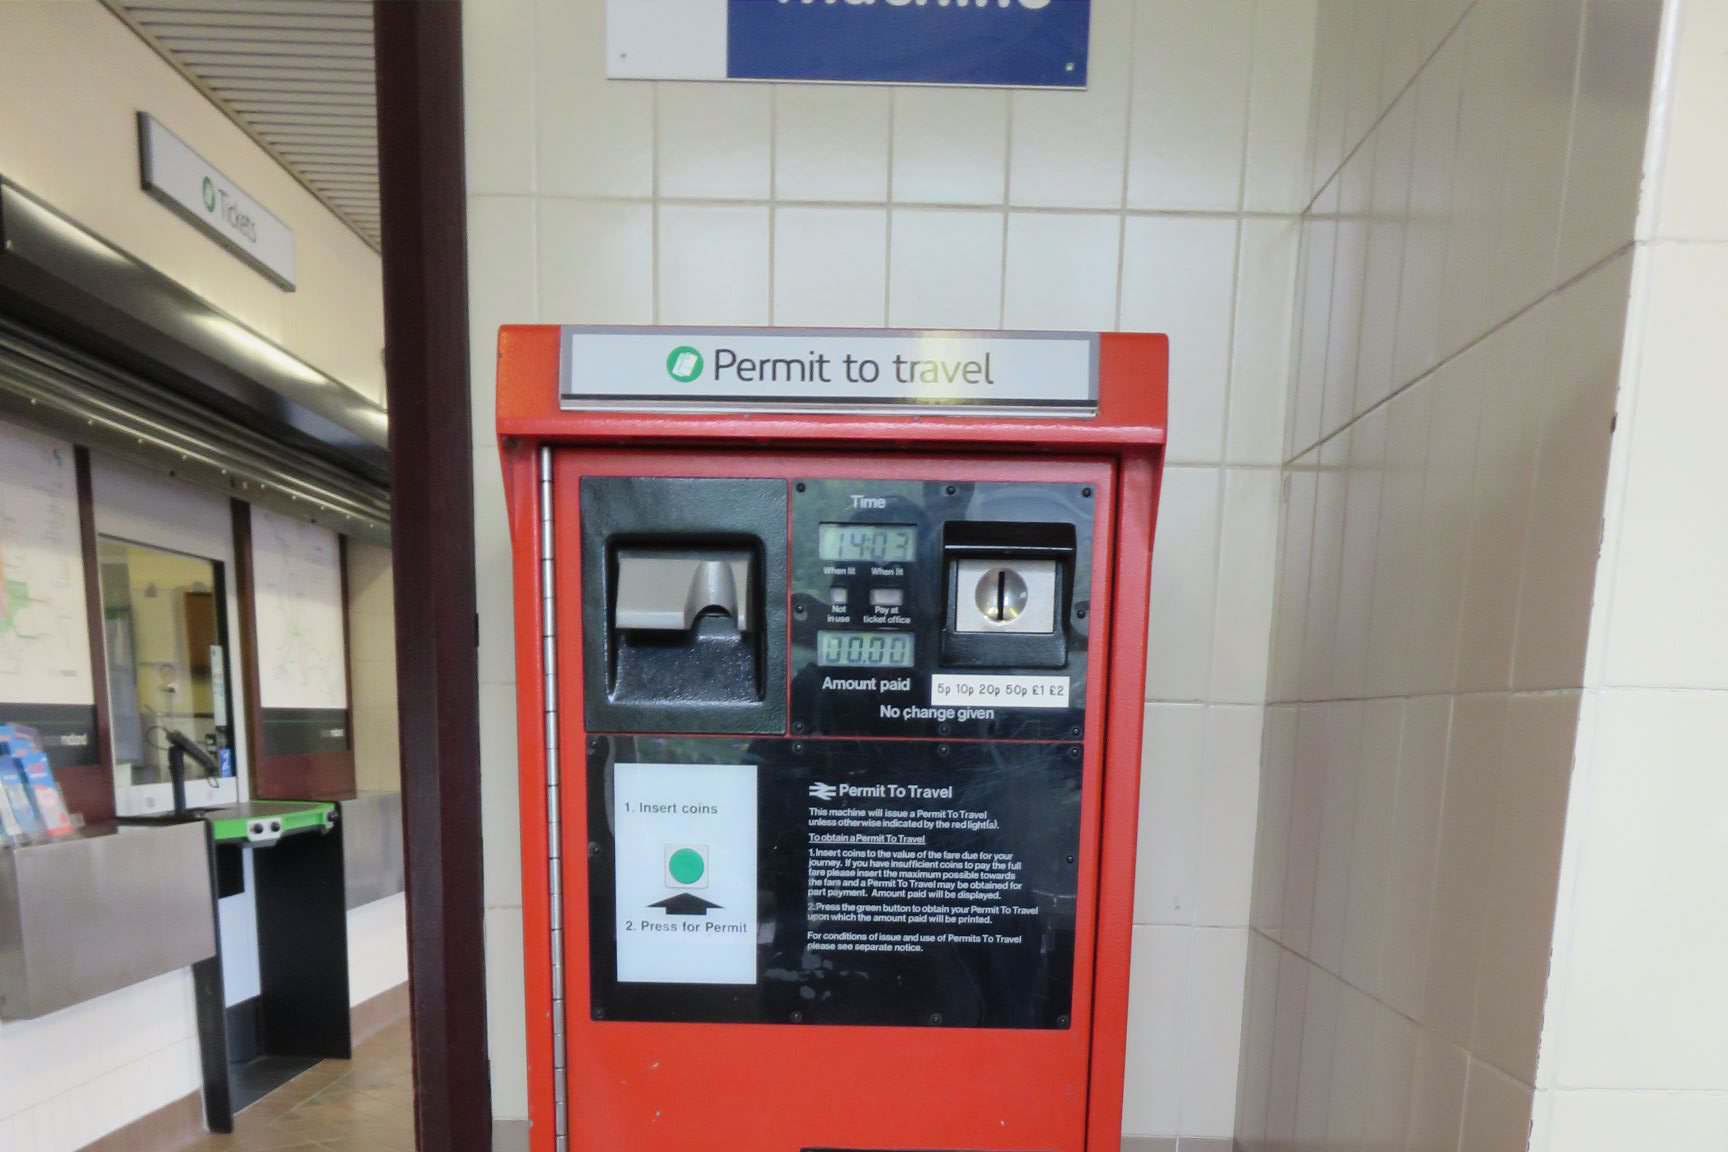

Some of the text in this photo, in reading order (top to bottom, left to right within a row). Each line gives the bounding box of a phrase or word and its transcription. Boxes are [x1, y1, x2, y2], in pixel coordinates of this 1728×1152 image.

[714, 348, 994, 384] Permit to travel
[850, 494, 886, 509] Time
[823, 566, 856, 575] When lit
[871, 567, 904, 576] When lit
[832, 605, 846, 613] Not
[874, 606, 899, 615] Pay at
[827, 614, 850, 623] in use
[863, 614, 911, 625] ticket office
[822, 676, 910, 694] Amount paid
[937, 682, 1064, 697] 5p 10p 20p 50p £1 £2
[880, 705, 995, 721] No change given
[839, 784, 952, 799] Permit To Travel
[624, 802, 718, 814] 1. Insert coins
[809, 808, 827, 817] This
[829, 808, 865, 817] machine
[868, 809, 882, 817] will
[885, 809, 908, 818] issue
[917, 809, 946, 818] Permit
[947, 810, 958, 818] To
[959, 810, 987, 819] Travel
[809, 818, 999, 831] unless otherwise indicated by the red light(s).
[809, 833, 821, 841] To
[821, 833, 848, 842] obtain
[856, 833, 885, 842] Permit
[886, 834, 897, 842] To
[898, 834, 925, 843] Travel
[842, 848, 866, 857] coins
[867, 849, 876, 858] to
[878, 849, 892, 858] the
[893, 849, 915, 858] value
[917, 850, 927, 858] of
[928, 850, 942, 859] the
[943, 850, 960, 859] fare
[962, 850, 978, 859] due
[980, 851, 992, 859] for
[994, 853, 1013, 862] your
[808, 858, 1021, 871] journey. If you have insufficient coins to pay the full
[808, 868, 1016, 881] fare please insert the maximum possible towards
[808, 878, 822, 887] the
[824, 878, 841, 887] fare
[842, 878, 859, 887] and
[868, 879, 896, 888] Permit
[897, 879, 908, 888] To
[909, 879, 936, 888] Travel
[937, 881, 955, 890] may
[957, 880, 968, 889] be
[970, 880, 1008, 889] obtained
[1010, 881, 1023, 890] for
[808, 887, 1001, 901] part payment. Amount paid will be displayed.
[842, 903, 855, 911] the
[857, 905, 881, 914] green
[883, 903, 911, 912] button
[912, 904, 921, 912] to
[922, 904, 949, 913] obtain
[951, 906, 970, 915] your
[971, 905, 999, 914] Permit
[1001, 905, 1011, 914] To
[1013, 906, 1038, 915] Travel
[808, 912, 992, 925] upon which the amount paid will be printed.
[625, 921, 747, 933] 2. Press for Permit
[808, 931, 822, 939] For
[823, 931, 867, 940] conditions
[869, 932, 878, 941] of
[880, 932, 901, 941] issue
[903, 933, 919, 941] and
[937, 933, 946, 942] of
[948, 933, 981, 943] Permits
[982, 934, 993, 943] To
[995, 934, 1021, 943] Travel
[808, 941, 835, 952] please
[855, 942, 893, 953] separate
[894, 943, 923, 952] notice.
